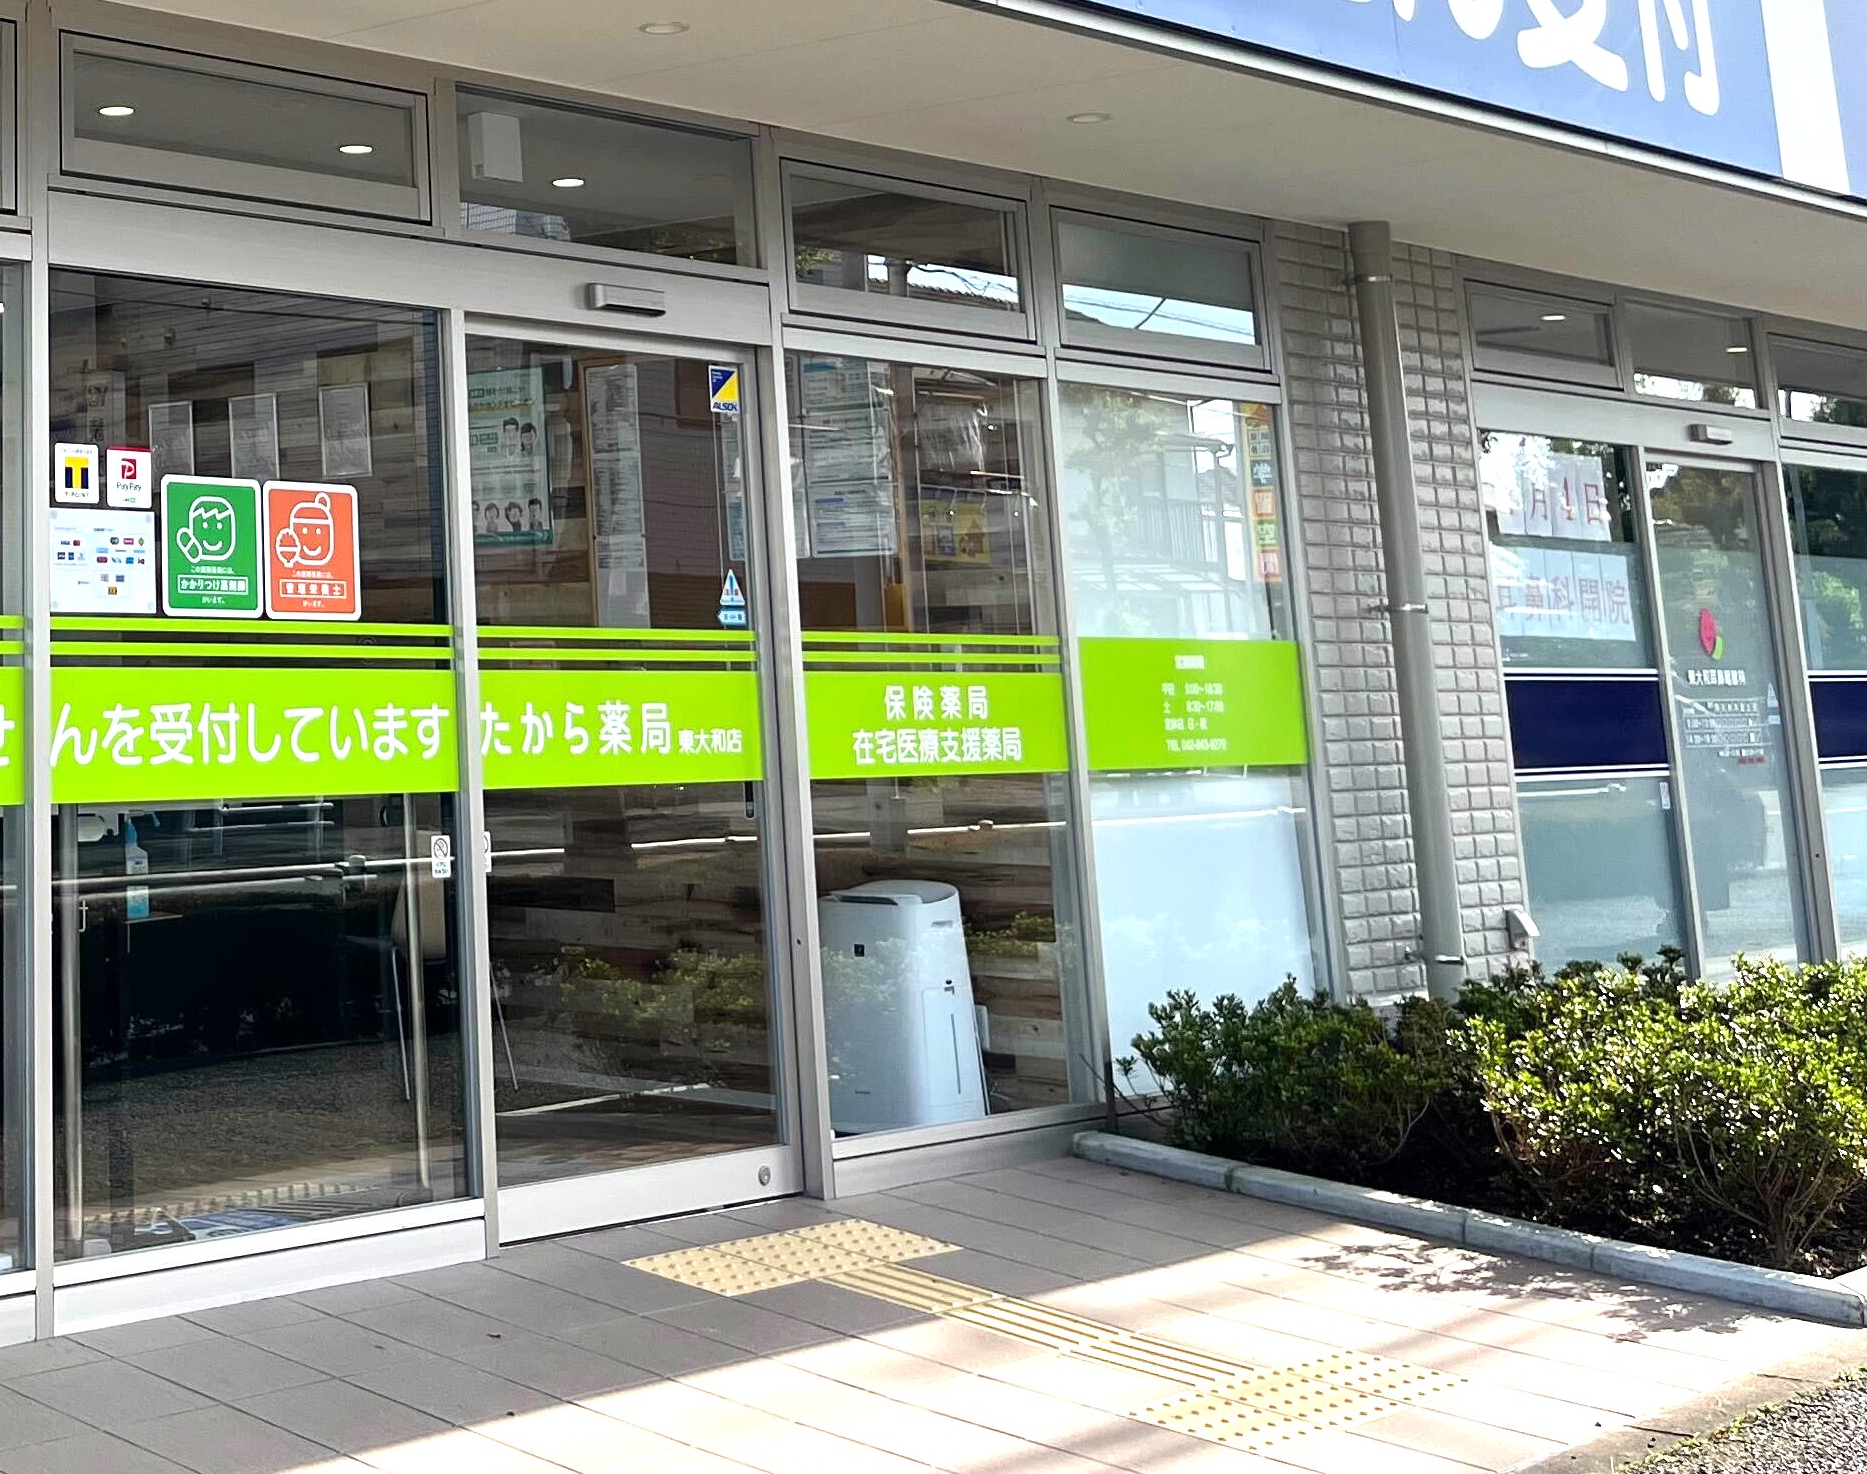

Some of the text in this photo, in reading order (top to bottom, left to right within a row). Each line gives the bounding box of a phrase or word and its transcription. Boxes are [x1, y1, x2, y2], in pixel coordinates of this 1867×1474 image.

[713, 402, 738, 412] ALSOK
[116, 481, 142, 492] PayPay
[884, 685, 989, 721] 保険薬局
[480, 700, 672, 756] たから薬局
[678, 728, 744, 755] 東大和店
[851, 726, 1023, 766] 在宅医療支援薬局
